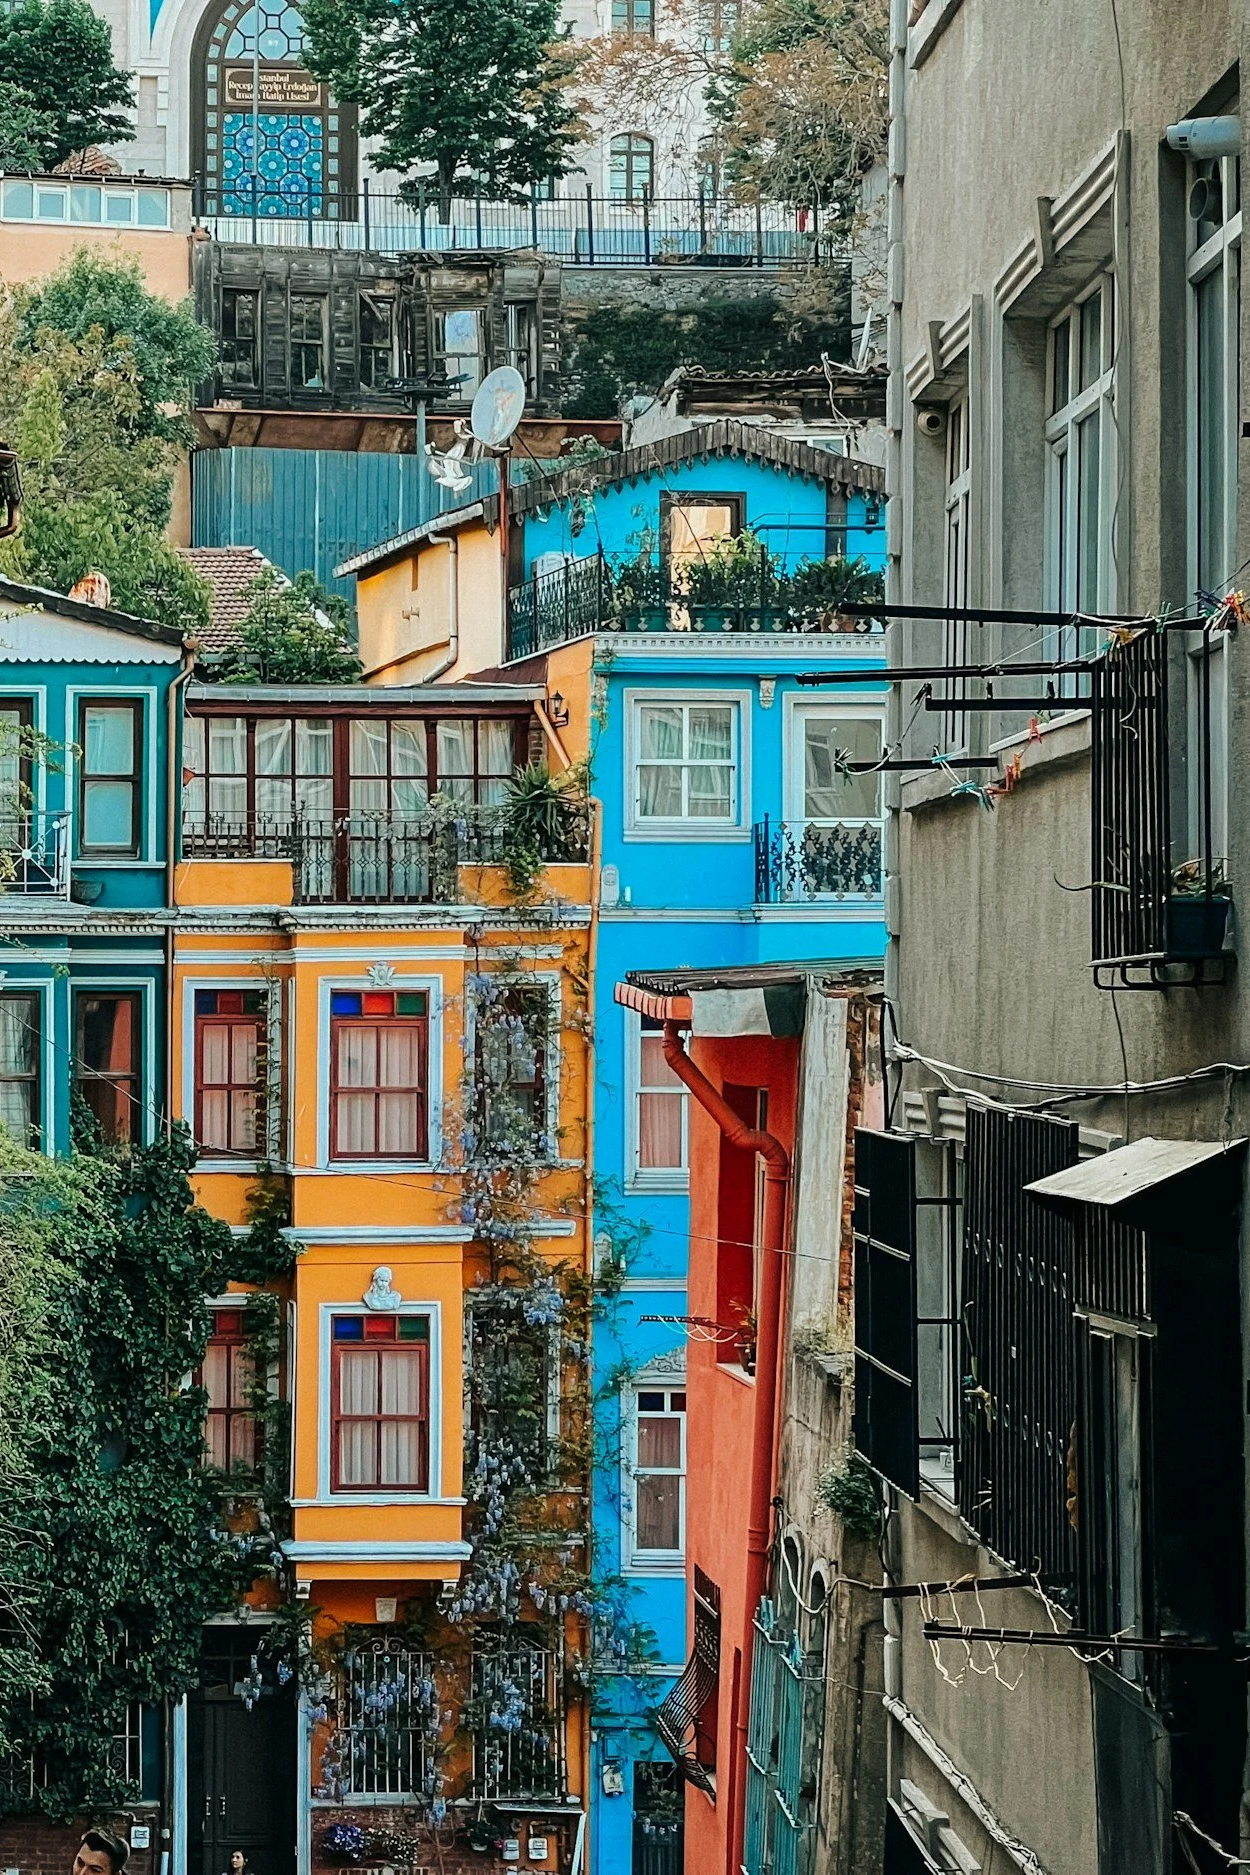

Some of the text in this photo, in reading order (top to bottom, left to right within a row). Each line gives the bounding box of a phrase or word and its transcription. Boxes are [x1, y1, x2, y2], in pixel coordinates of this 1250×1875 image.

[258, 73, 290, 82] stanbul
[228, 81, 318, 92] Recep ayyip Erdoğan
[262, 91, 285, 101] Hatip
[286, 92, 310, 101] Lisesi
